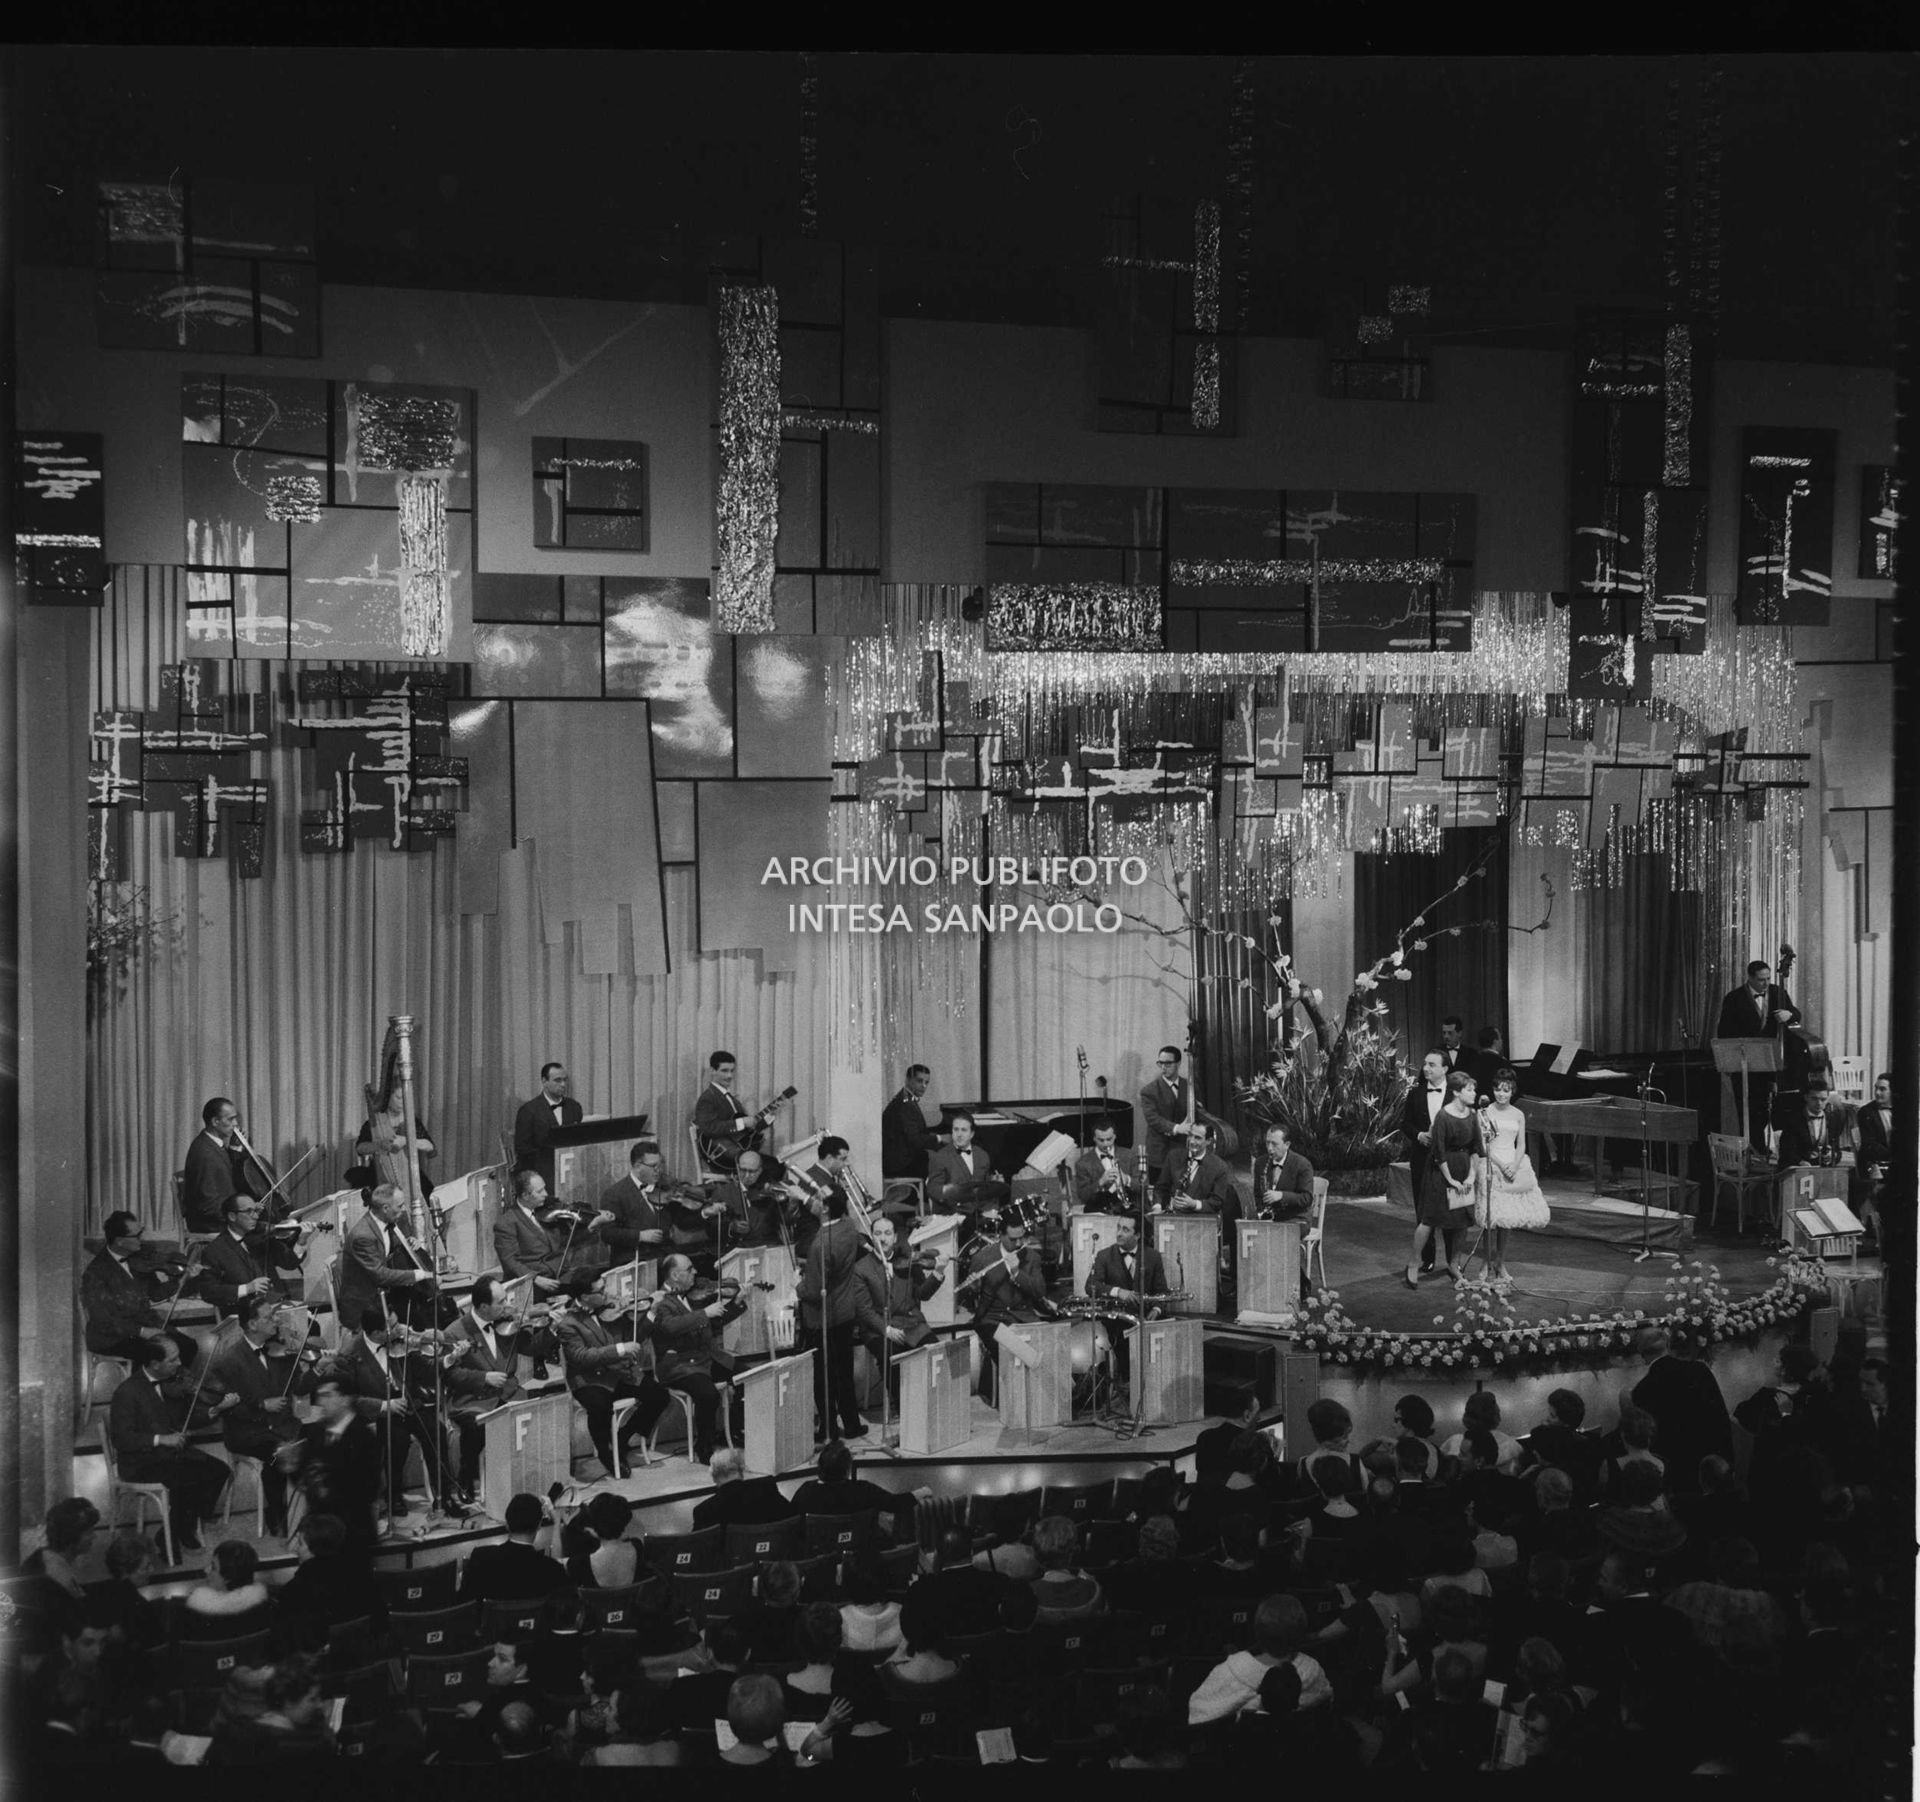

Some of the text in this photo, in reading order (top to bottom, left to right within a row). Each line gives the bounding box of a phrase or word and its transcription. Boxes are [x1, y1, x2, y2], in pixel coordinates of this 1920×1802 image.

[560, 1153, 575, 1184] F
[478, 1179, 488, 1211] F
[1078, 1223, 1094, 1252] F
[1158, 1223, 1175, 1253] F
[1242, 1229, 1258, 1258] F
[744, 1258, 760, 1285] F
[1150, 1332, 1165, 1363] F
[932, 1354, 944, 1388] F
[779, 1371, 790, 1407] F
[516, 1413, 532, 1451] F
